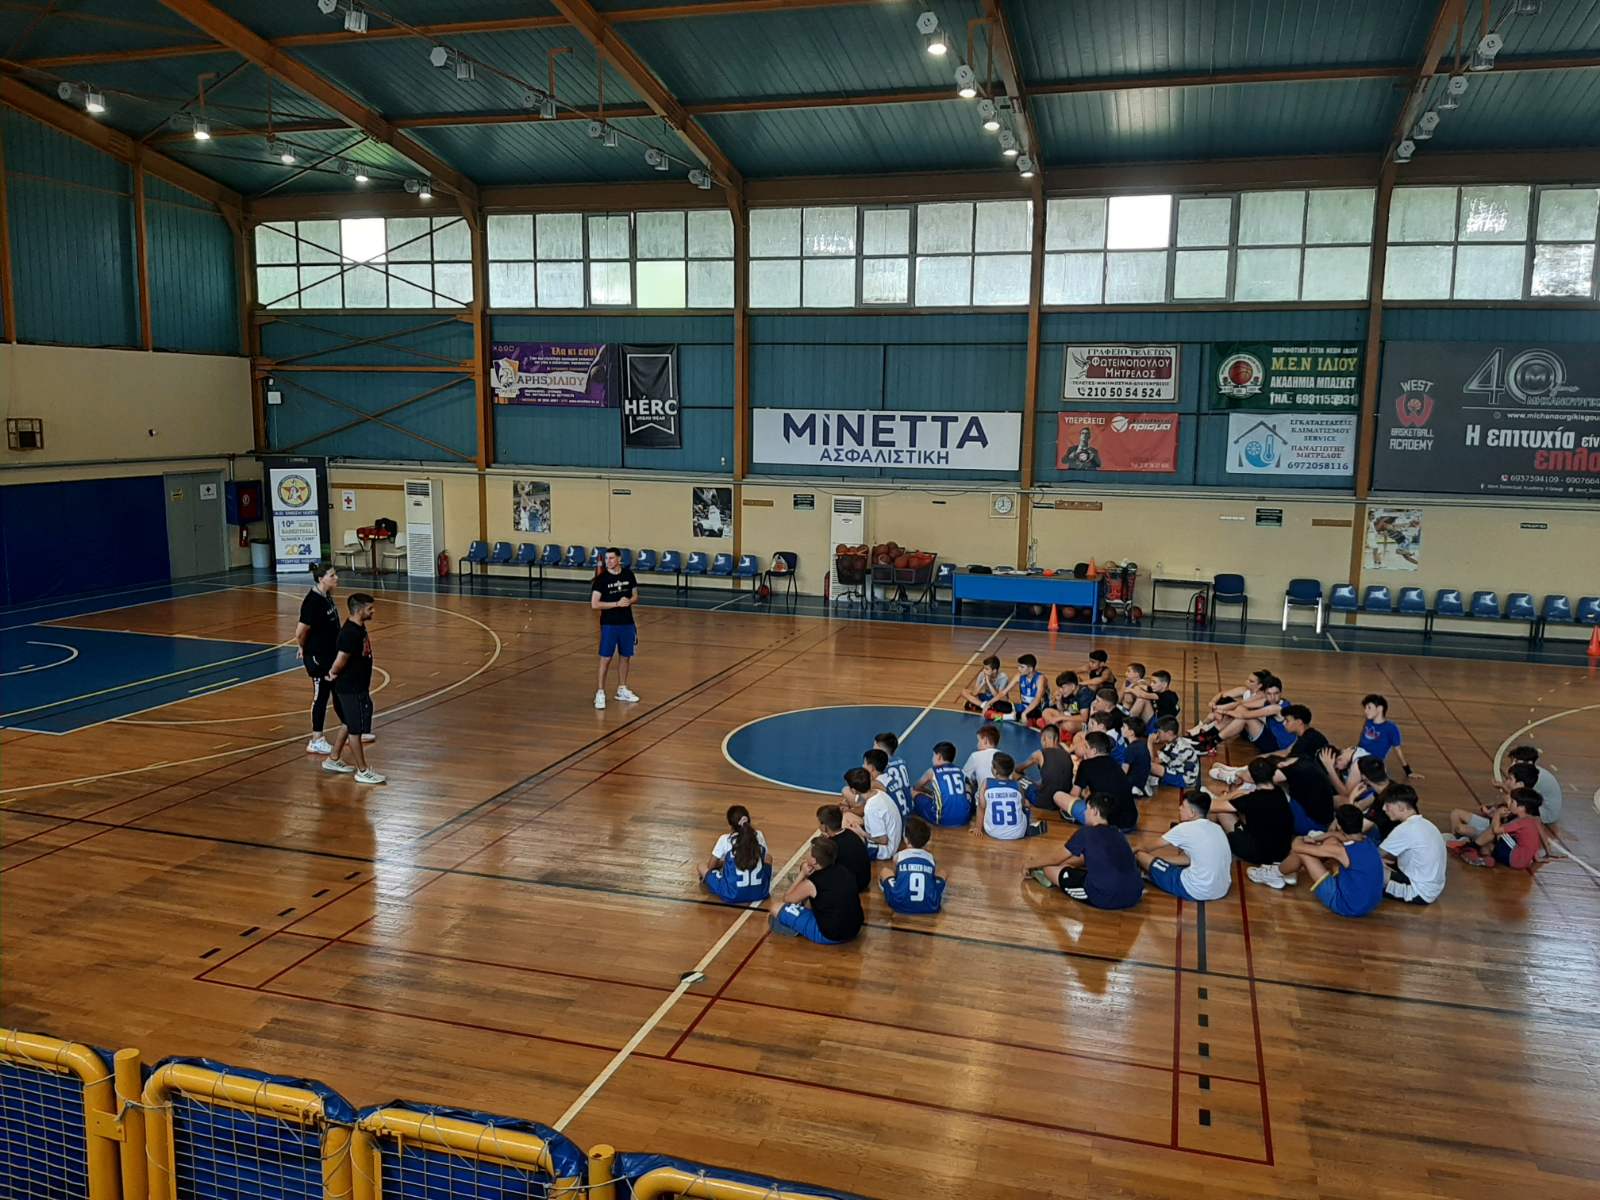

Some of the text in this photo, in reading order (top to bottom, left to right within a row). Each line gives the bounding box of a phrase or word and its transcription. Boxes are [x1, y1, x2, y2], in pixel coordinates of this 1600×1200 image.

[1091, 356, 1170, 368] ΦΩΤΕΙΝΟΠΟΥΛΟΥ
[1317, 357, 1358, 371] ΙΛΙΟΥ
[1105, 367, 1156, 378] ΜΗΤΡΕΛΟΣ
[1270, 375, 1357, 389] ΑΚΑΔΗΜΙΑ ΜΠΑΣΚΕΤ
[1400, 379, 1435, 393] WEST
[1087, 387, 1107, 397] 210
[783, 412, 989, 449] MINETTA
[1390, 427, 1435, 438] BASKETBALL
[1465, 424, 1481, 446] Η
[1486, 426, 1576, 449] επιτυχία
[1389, 438, 1435, 451] ACADEMY
[819, 447, 950, 465] ΑΣΦΑΛΙΣΤΙΚΗ
[943, 773, 965, 795] 15
[991, 800, 1018, 826] 63
[909, 872, 926, 902] 9
